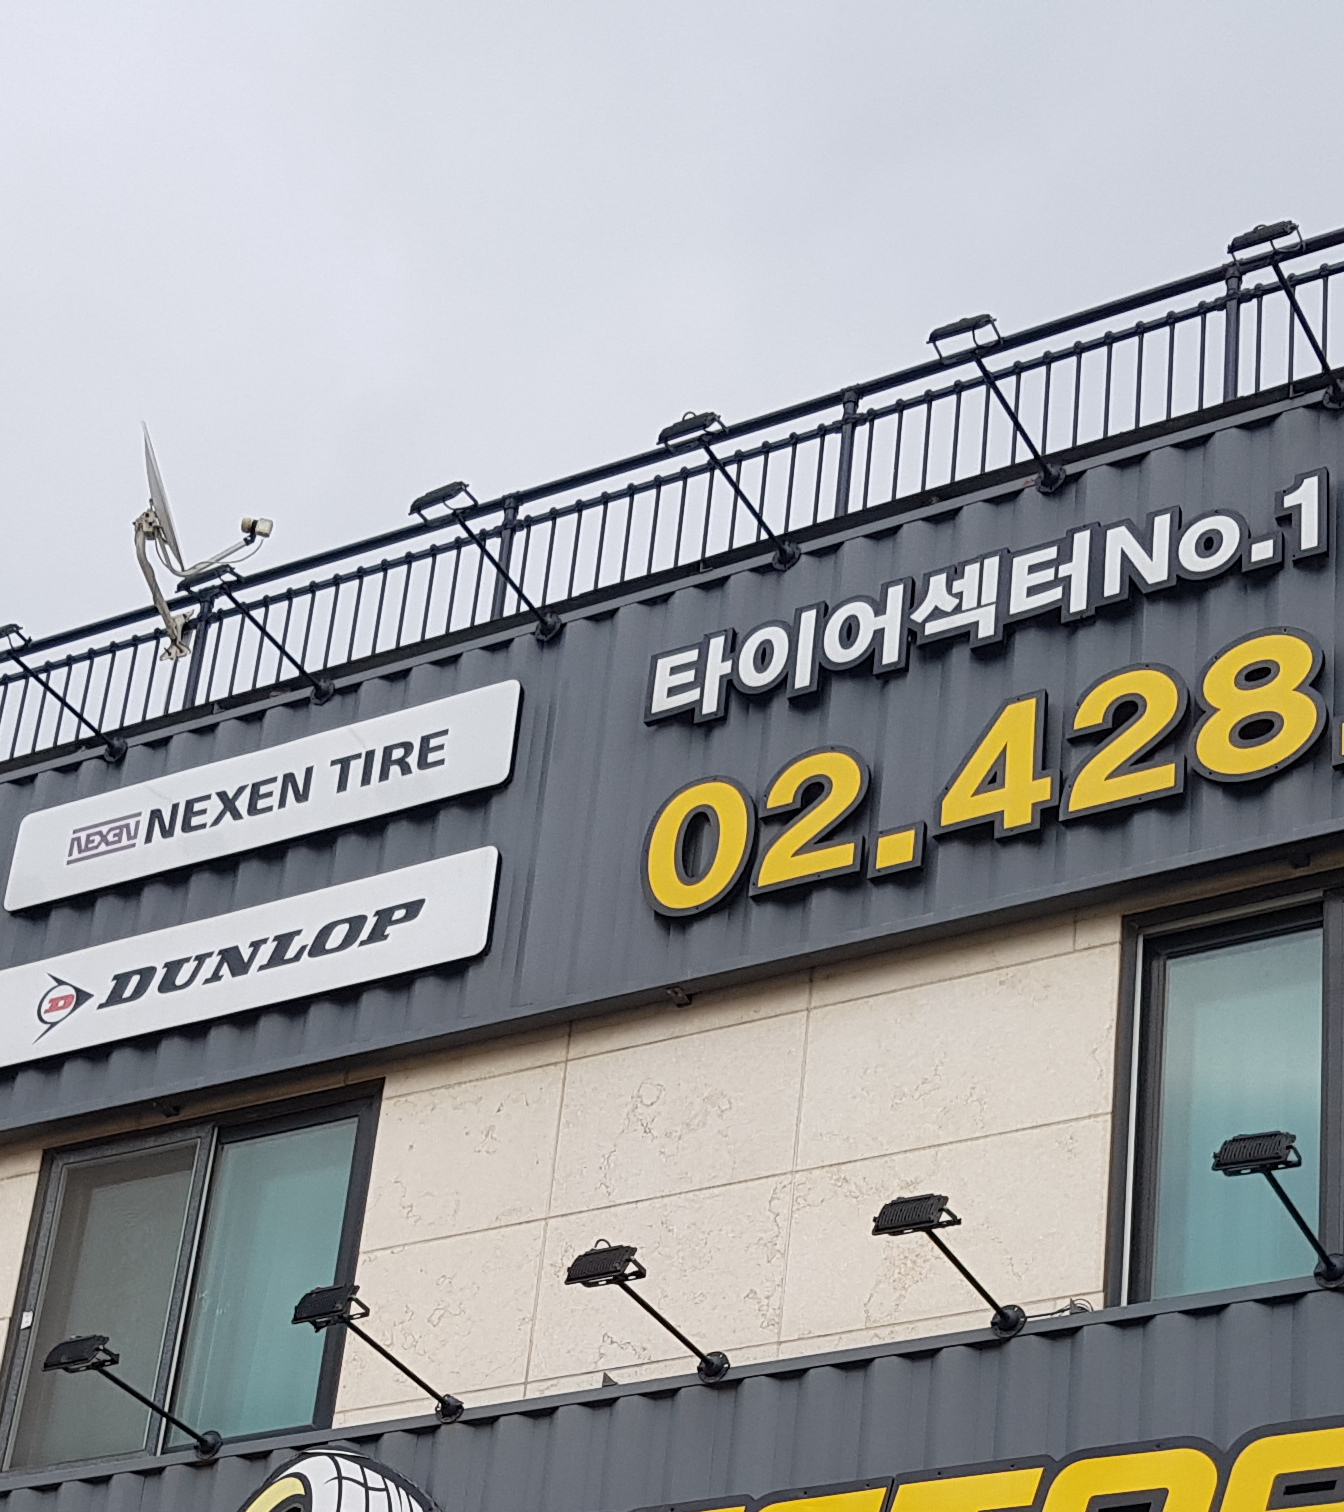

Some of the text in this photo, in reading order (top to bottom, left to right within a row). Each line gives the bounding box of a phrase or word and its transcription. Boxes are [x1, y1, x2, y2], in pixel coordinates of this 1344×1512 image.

[650, 475, 1327, 720] 타이어섹터No.1
[144, 765, 314, 845] NEXEN
[330, 728, 450, 794] TIRE
[96, 898, 426, 1011] DUNLOP
